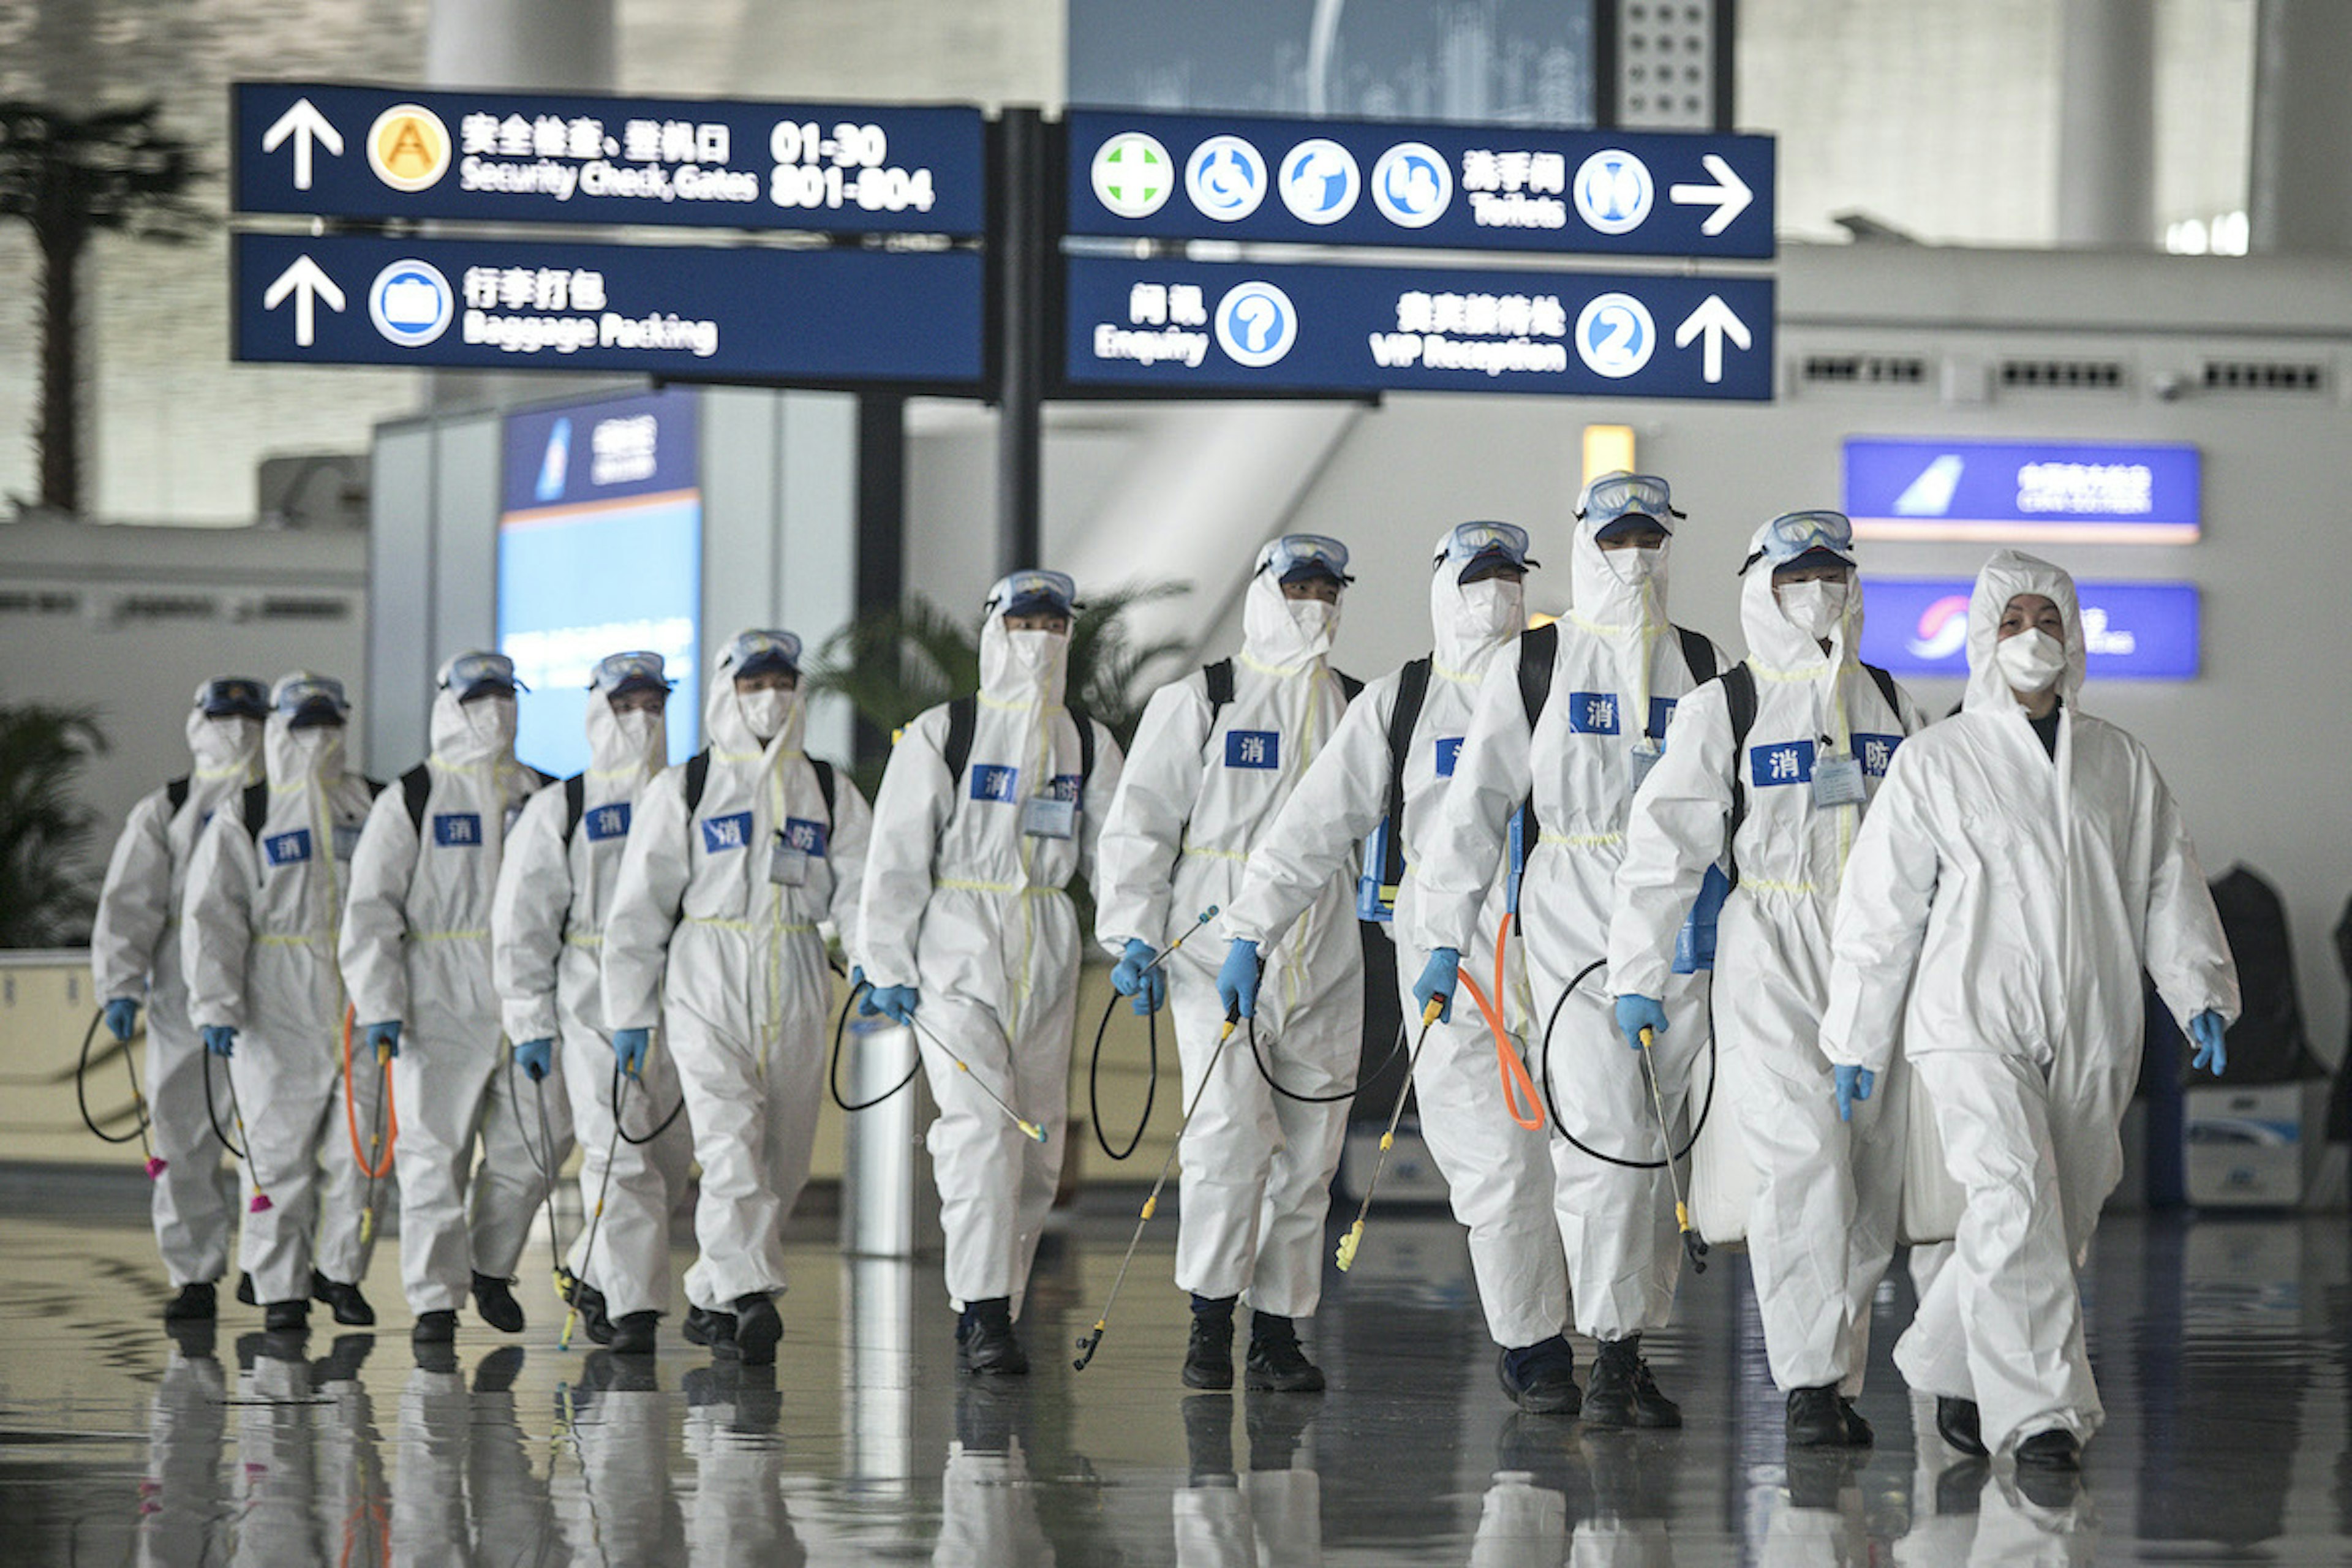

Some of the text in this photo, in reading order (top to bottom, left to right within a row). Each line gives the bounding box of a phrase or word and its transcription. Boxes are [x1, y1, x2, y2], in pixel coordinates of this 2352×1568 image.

[770, 120, 888, 167] 01-30
[461, 155, 578, 202] Security
[463, 309, 718, 357] Baggage Packing
[1596, 306, 1635, 364] 2
[1588, 701, 1613, 729] 消
[1240, 736, 1265, 764] 消
[1769, 748, 1800, 779] 消
